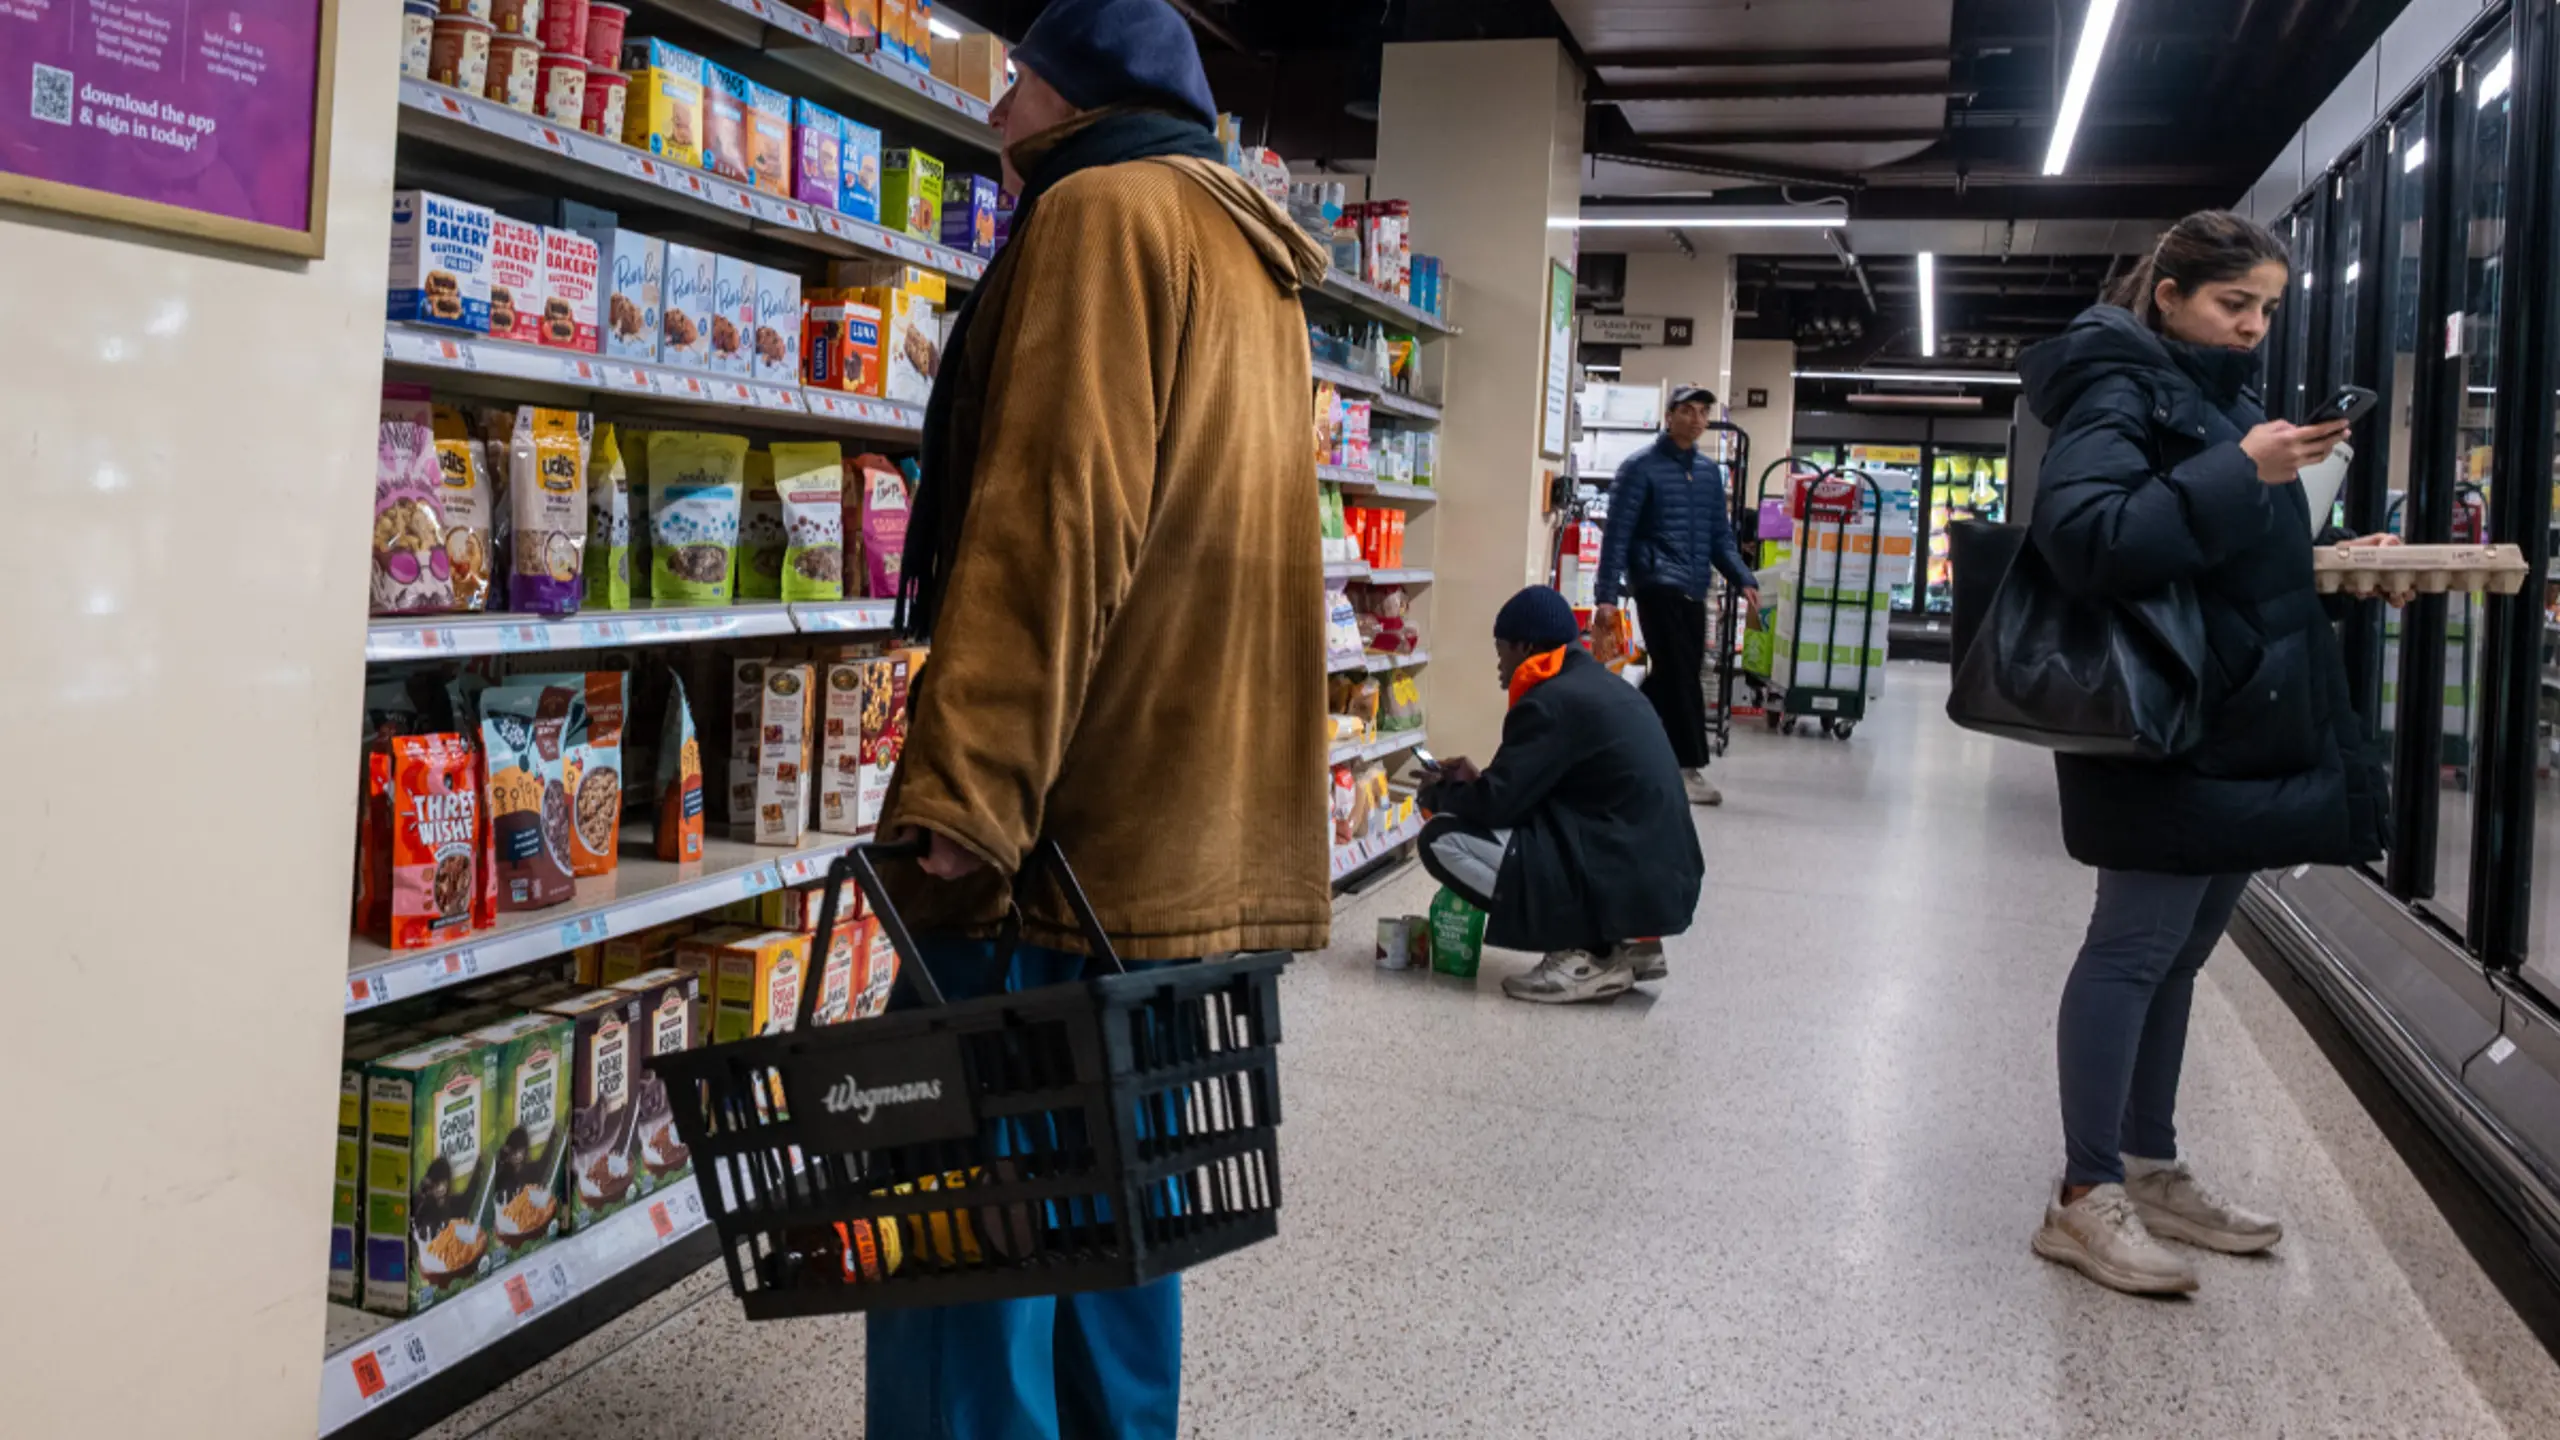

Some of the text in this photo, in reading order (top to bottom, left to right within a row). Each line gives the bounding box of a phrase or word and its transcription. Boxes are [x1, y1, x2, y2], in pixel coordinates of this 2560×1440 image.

[80, 82, 216, 135] download the app
[79, 105, 198, 153] & sign in today!
[426, 217, 489, 248] BAKERY
[464, 246, 483, 264] FREE
[493, 238, 539, 265] AKERY
[546, 251, 597, 277] BAKERY
[852, 322, 876, 341] LUNA
[815, 340, 826, 377] LUNA
[413, 789, 475, 823] THREE
[418, 816, 474, 846] WISHE
[820, 1073, 942, 1124] Wegmans
